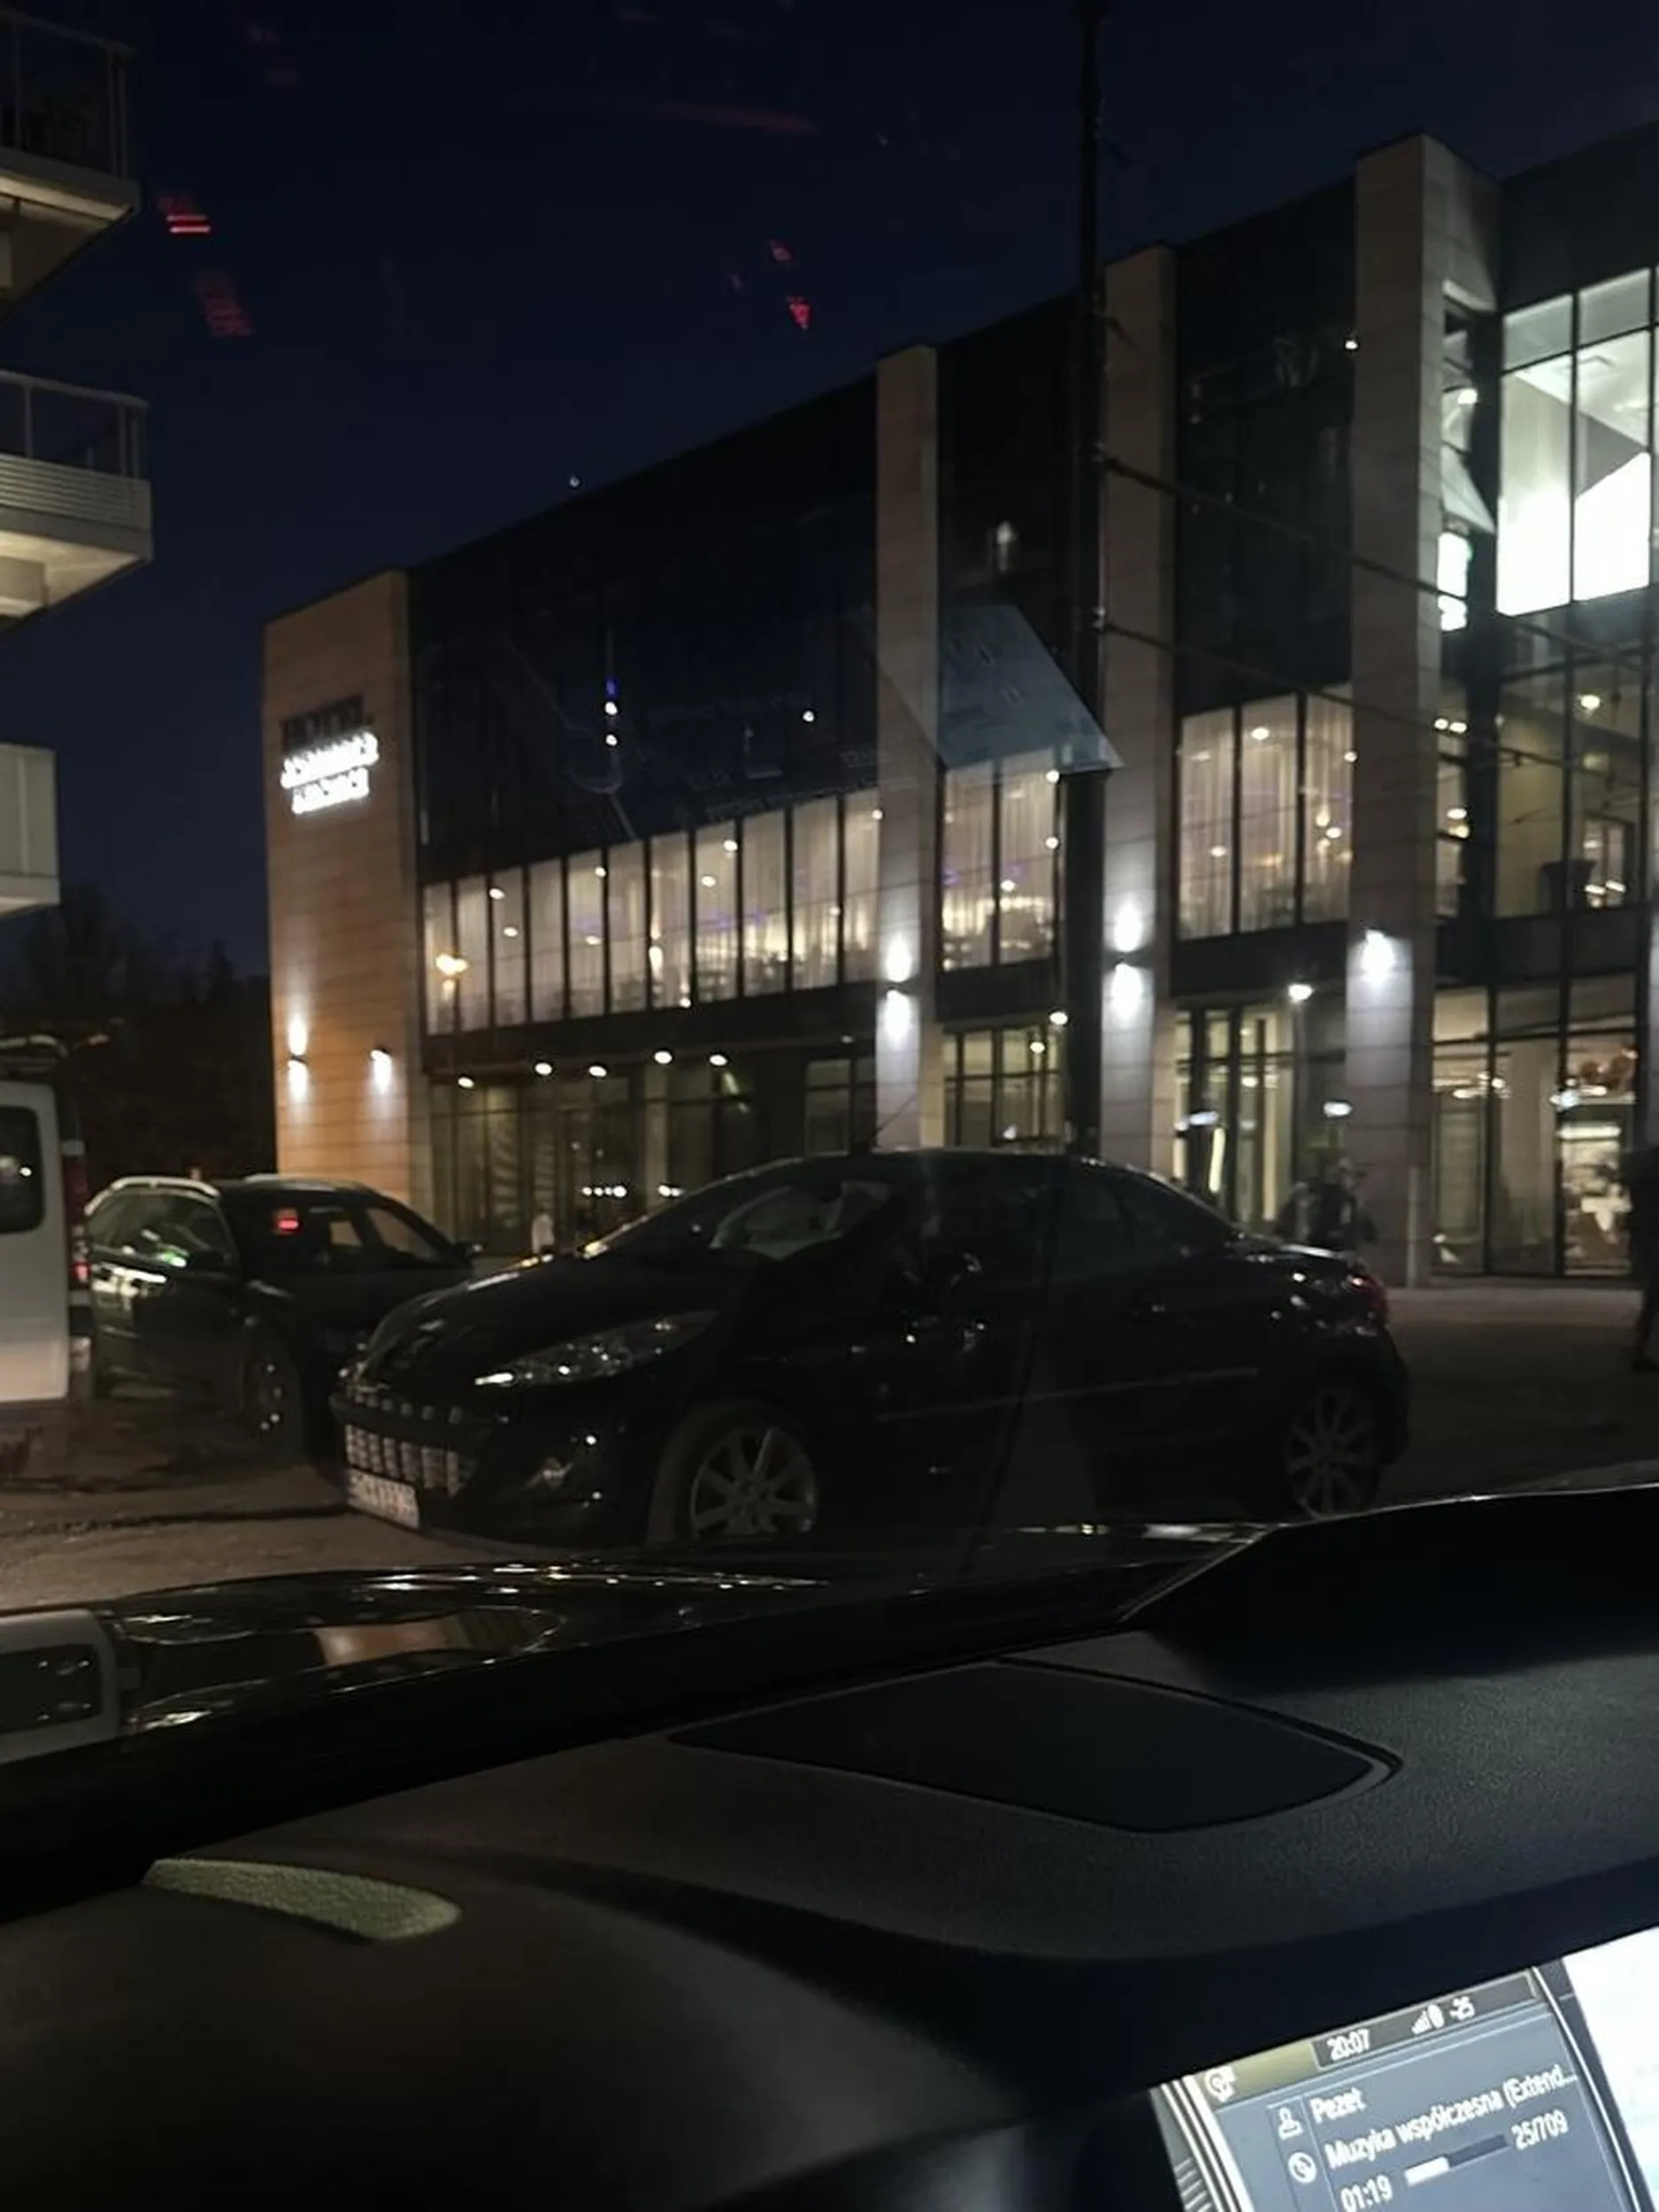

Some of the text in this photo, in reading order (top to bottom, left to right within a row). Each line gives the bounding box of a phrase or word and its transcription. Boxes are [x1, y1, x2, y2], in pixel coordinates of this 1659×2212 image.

[1327, 2029, 1370, 2061] 20:07
[1310, 2087, 1366, 2124] Pezet
[1325, 2128, 1396, 2170] Muzyka
[1395, 2089, 1503, 2143] współczesna
[1340, 2109, 1569, 2212] 01:19 25/709
